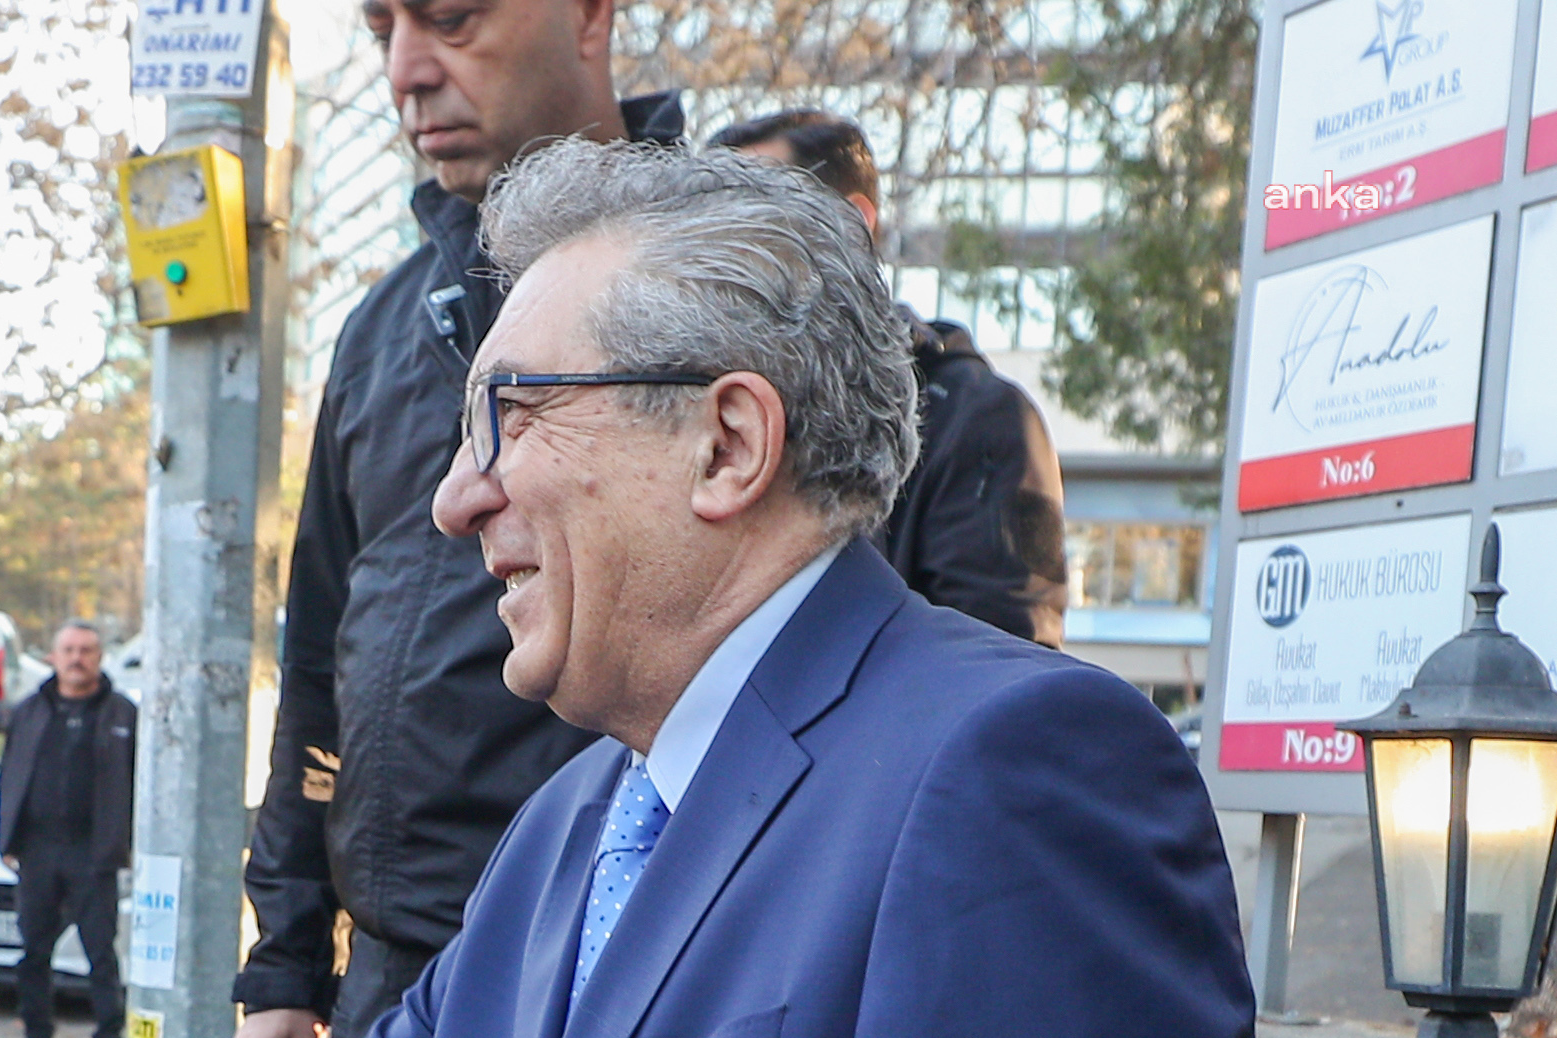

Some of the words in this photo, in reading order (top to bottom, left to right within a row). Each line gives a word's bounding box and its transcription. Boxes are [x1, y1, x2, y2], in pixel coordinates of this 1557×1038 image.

[132, 63, 172, 88] 232
[180, 63, 209, 88] 59
[216, 63, 247, 87] 40
[1315, 98, 1386, 141] MUZAFFER
[1389, 81, 1431, 115] POLAT
[1272, 264, 1450, 412] Anadolu
[1320, 450, 1376, 488] No:6
[1317, 558, 1373, 602] HUKUK
[1375, 549, 1443, 598] BÜROSU
[1276, 634, 1317, 670] Avukat
[1376, 626, 1423, 666] Avukat
[1282, 727, 1356, 764] No:9
